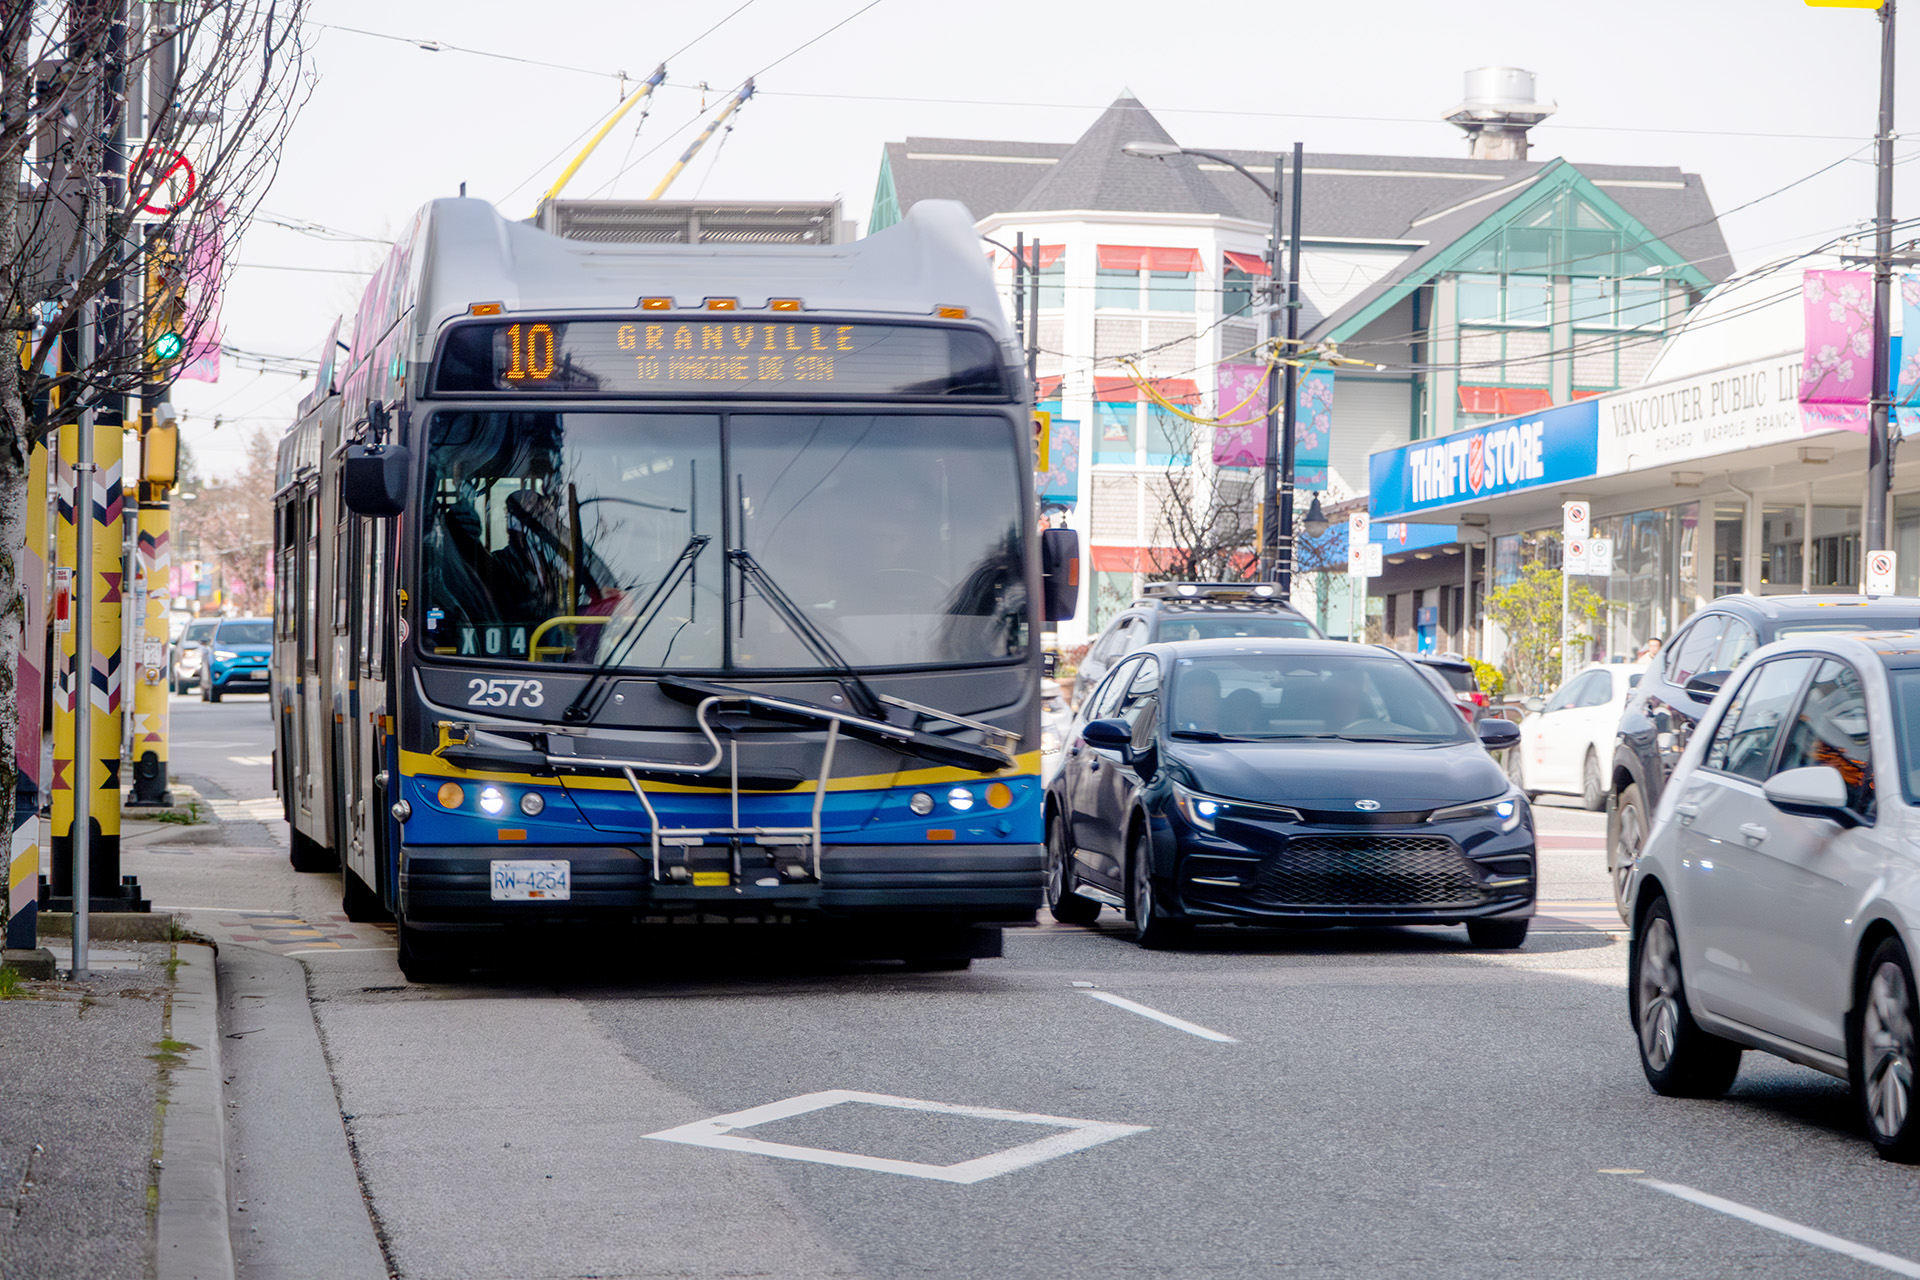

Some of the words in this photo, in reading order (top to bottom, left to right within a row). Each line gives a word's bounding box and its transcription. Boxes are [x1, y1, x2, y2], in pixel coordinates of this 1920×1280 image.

[506, 324, 553, 378] 10
[617, 325, 854, 350] GRANVILLE
[636, 355, 659, 380] TO
[1611, 386, 1704, 438] VANCOUVER
[1711, 370, 1767, 417] PUBLIC
[1655, 432, 1693, 452] RICHARD
[1703, 420, 1747, 443] MARPOLE
[1755, 410, 1797, 434] BRANCH
[1410, 438, 1469, 503] THRIFT
[1484, 420, 1545, 490] STORE
[467, 678, 544, 708] 2573
[494, 871, 566, 890] RW-4254
